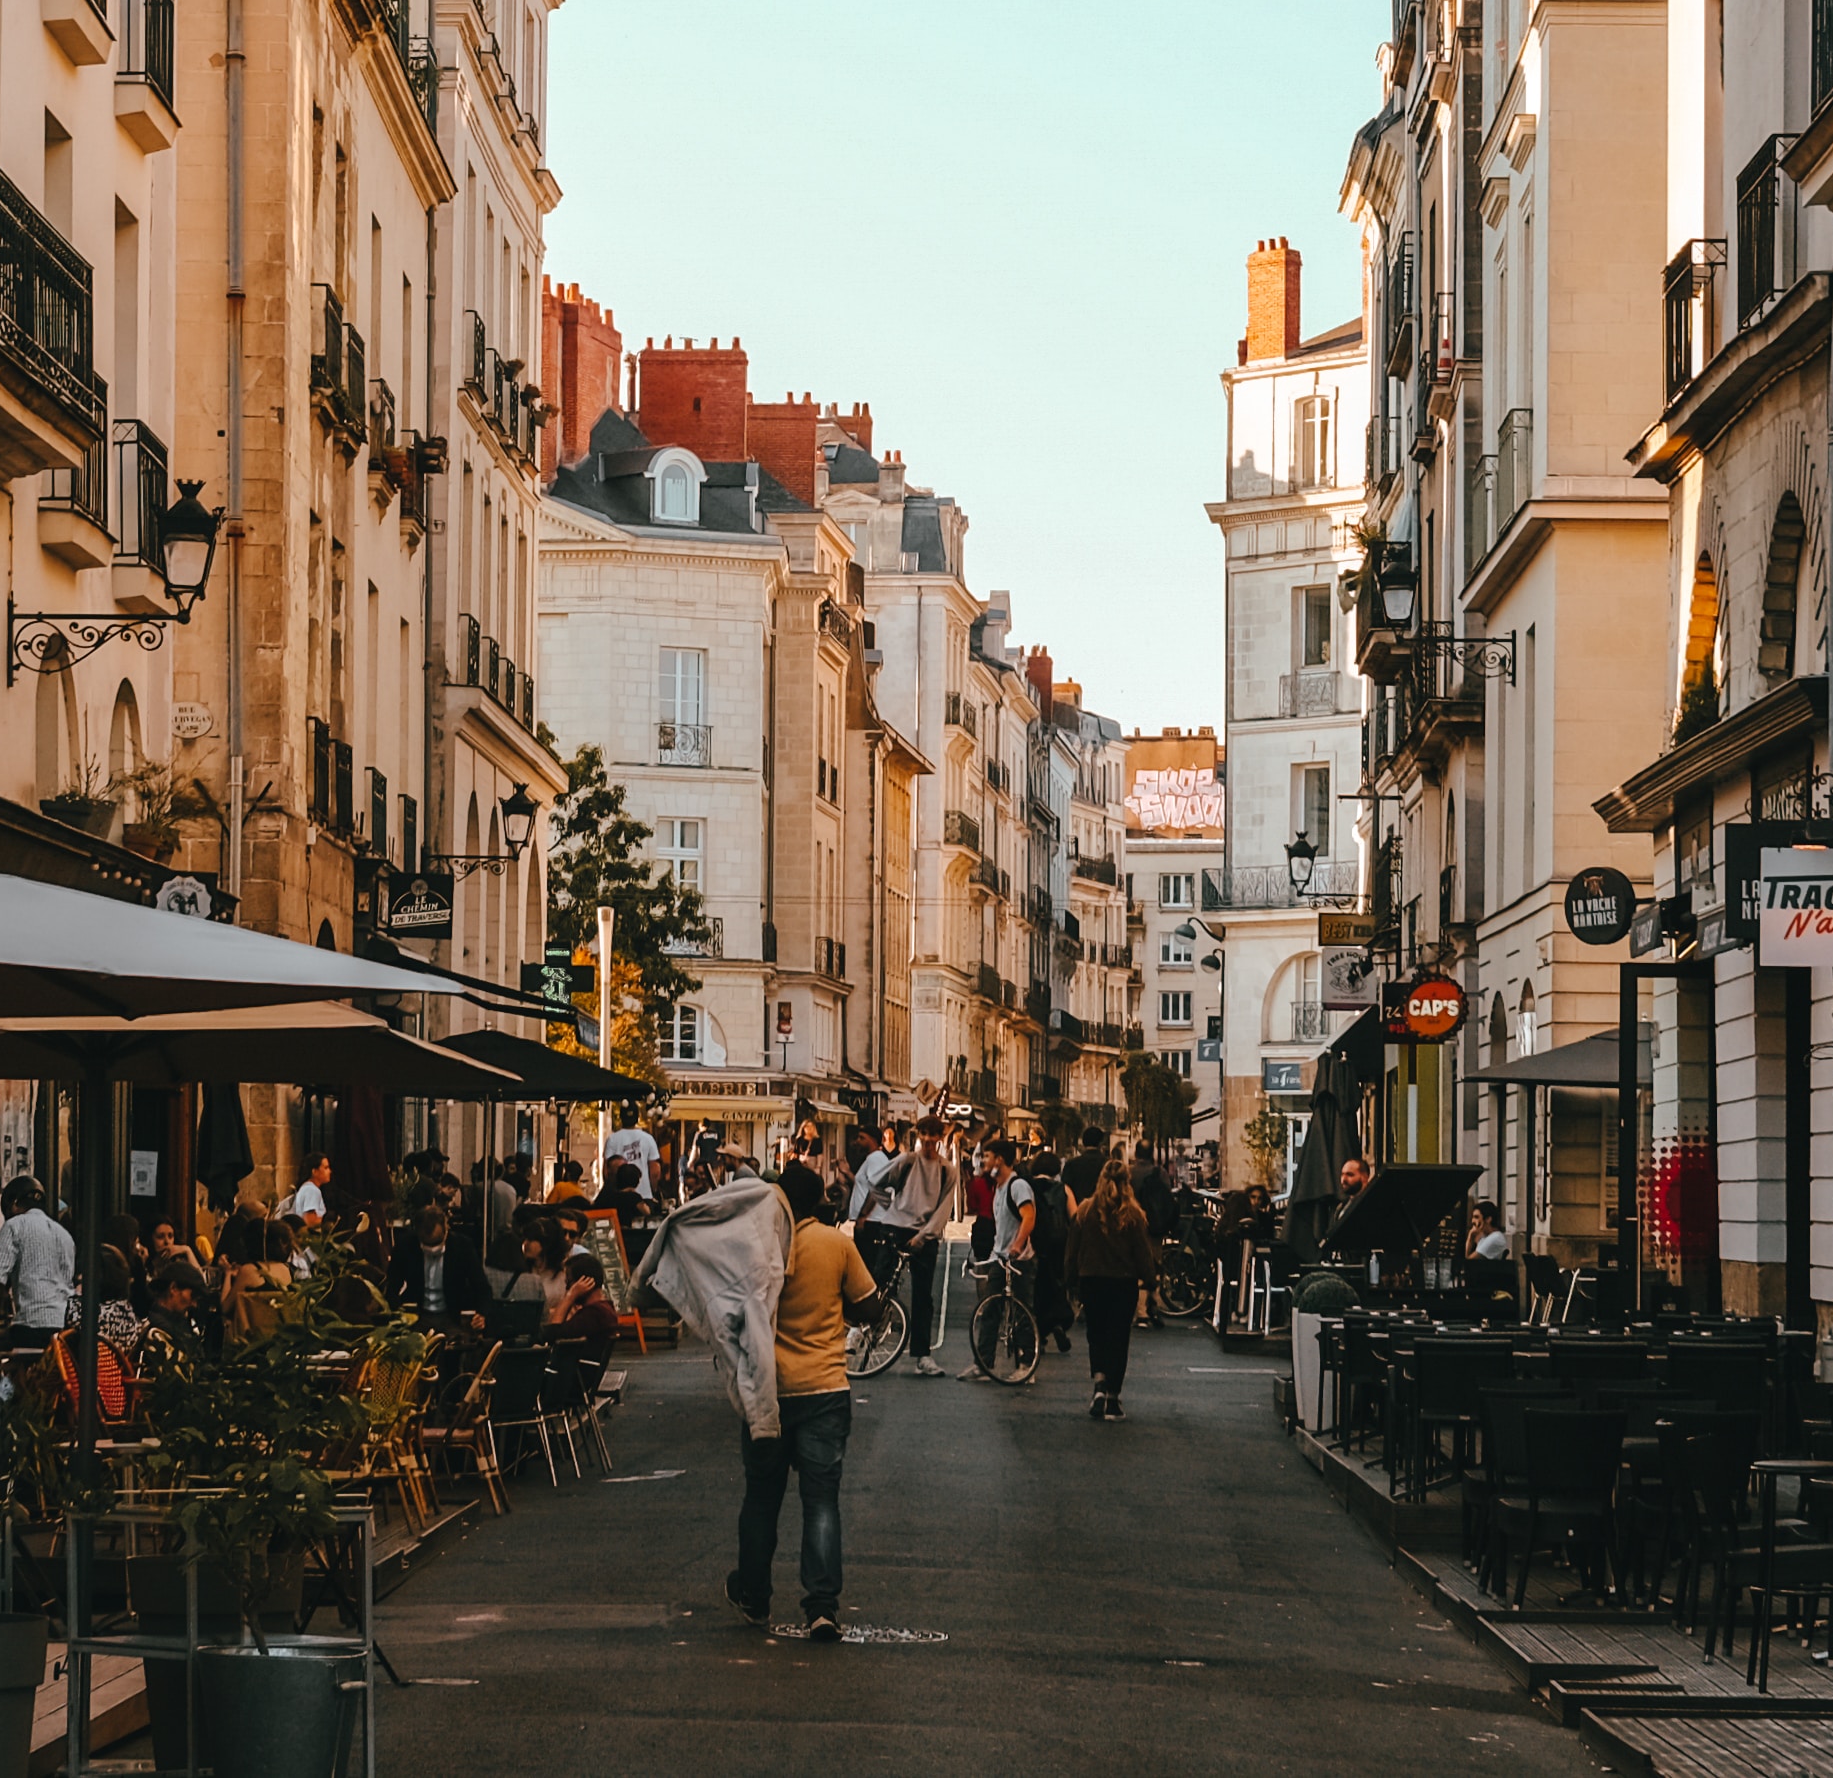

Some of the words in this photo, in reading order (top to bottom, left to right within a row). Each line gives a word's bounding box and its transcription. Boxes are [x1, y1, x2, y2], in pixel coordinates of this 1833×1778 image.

[400, 902, 439, 914] CHEMIN
[1572, 898, 1584, 914] LA
[1408, 999, 1460, 1017] CAP'S
